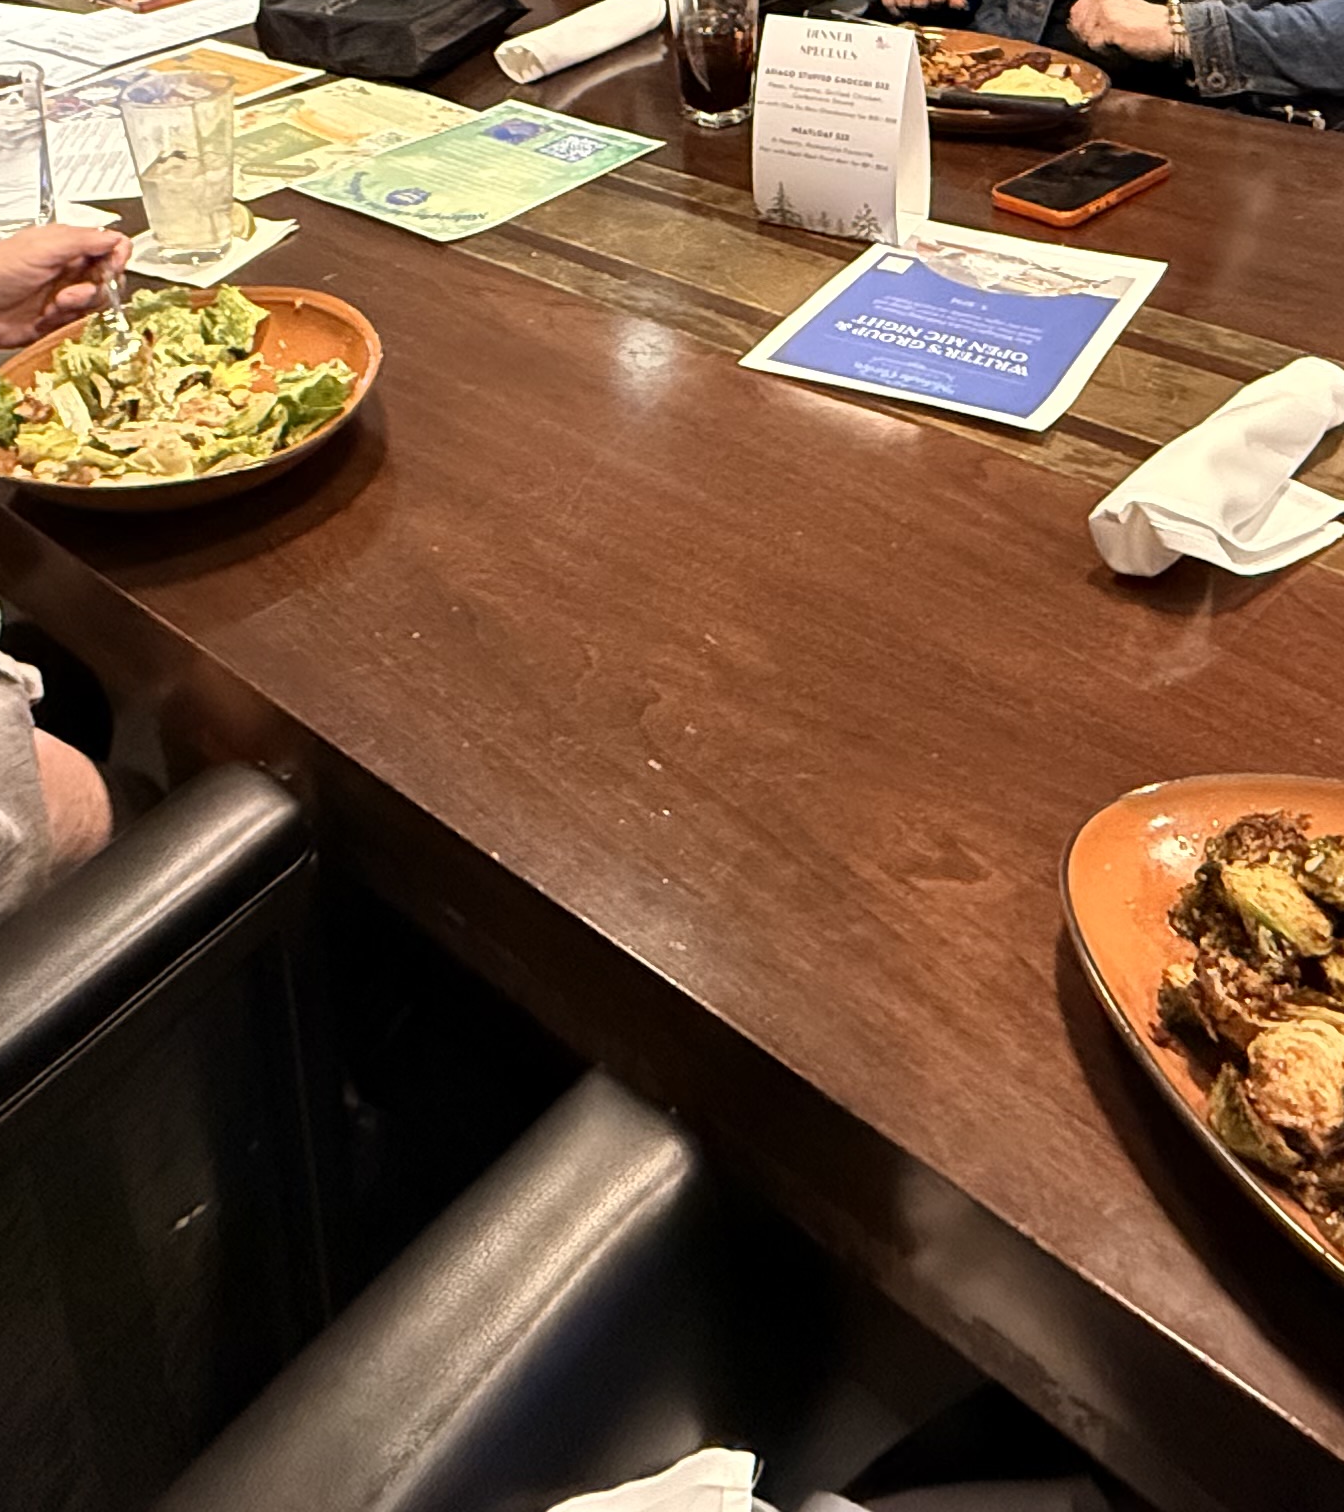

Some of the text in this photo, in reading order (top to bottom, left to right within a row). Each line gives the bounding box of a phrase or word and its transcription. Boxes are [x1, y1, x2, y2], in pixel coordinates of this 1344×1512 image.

[806, 28, 853, 43] DINNER
[800, 45, 858, 61] SPECIALS
[852, 314, 924, 338] NIGHT
[851, 326, 926, 349] GROUP
[923, 330, 968, 348] MIC
[968, 340, 1029, 363] OPEN
